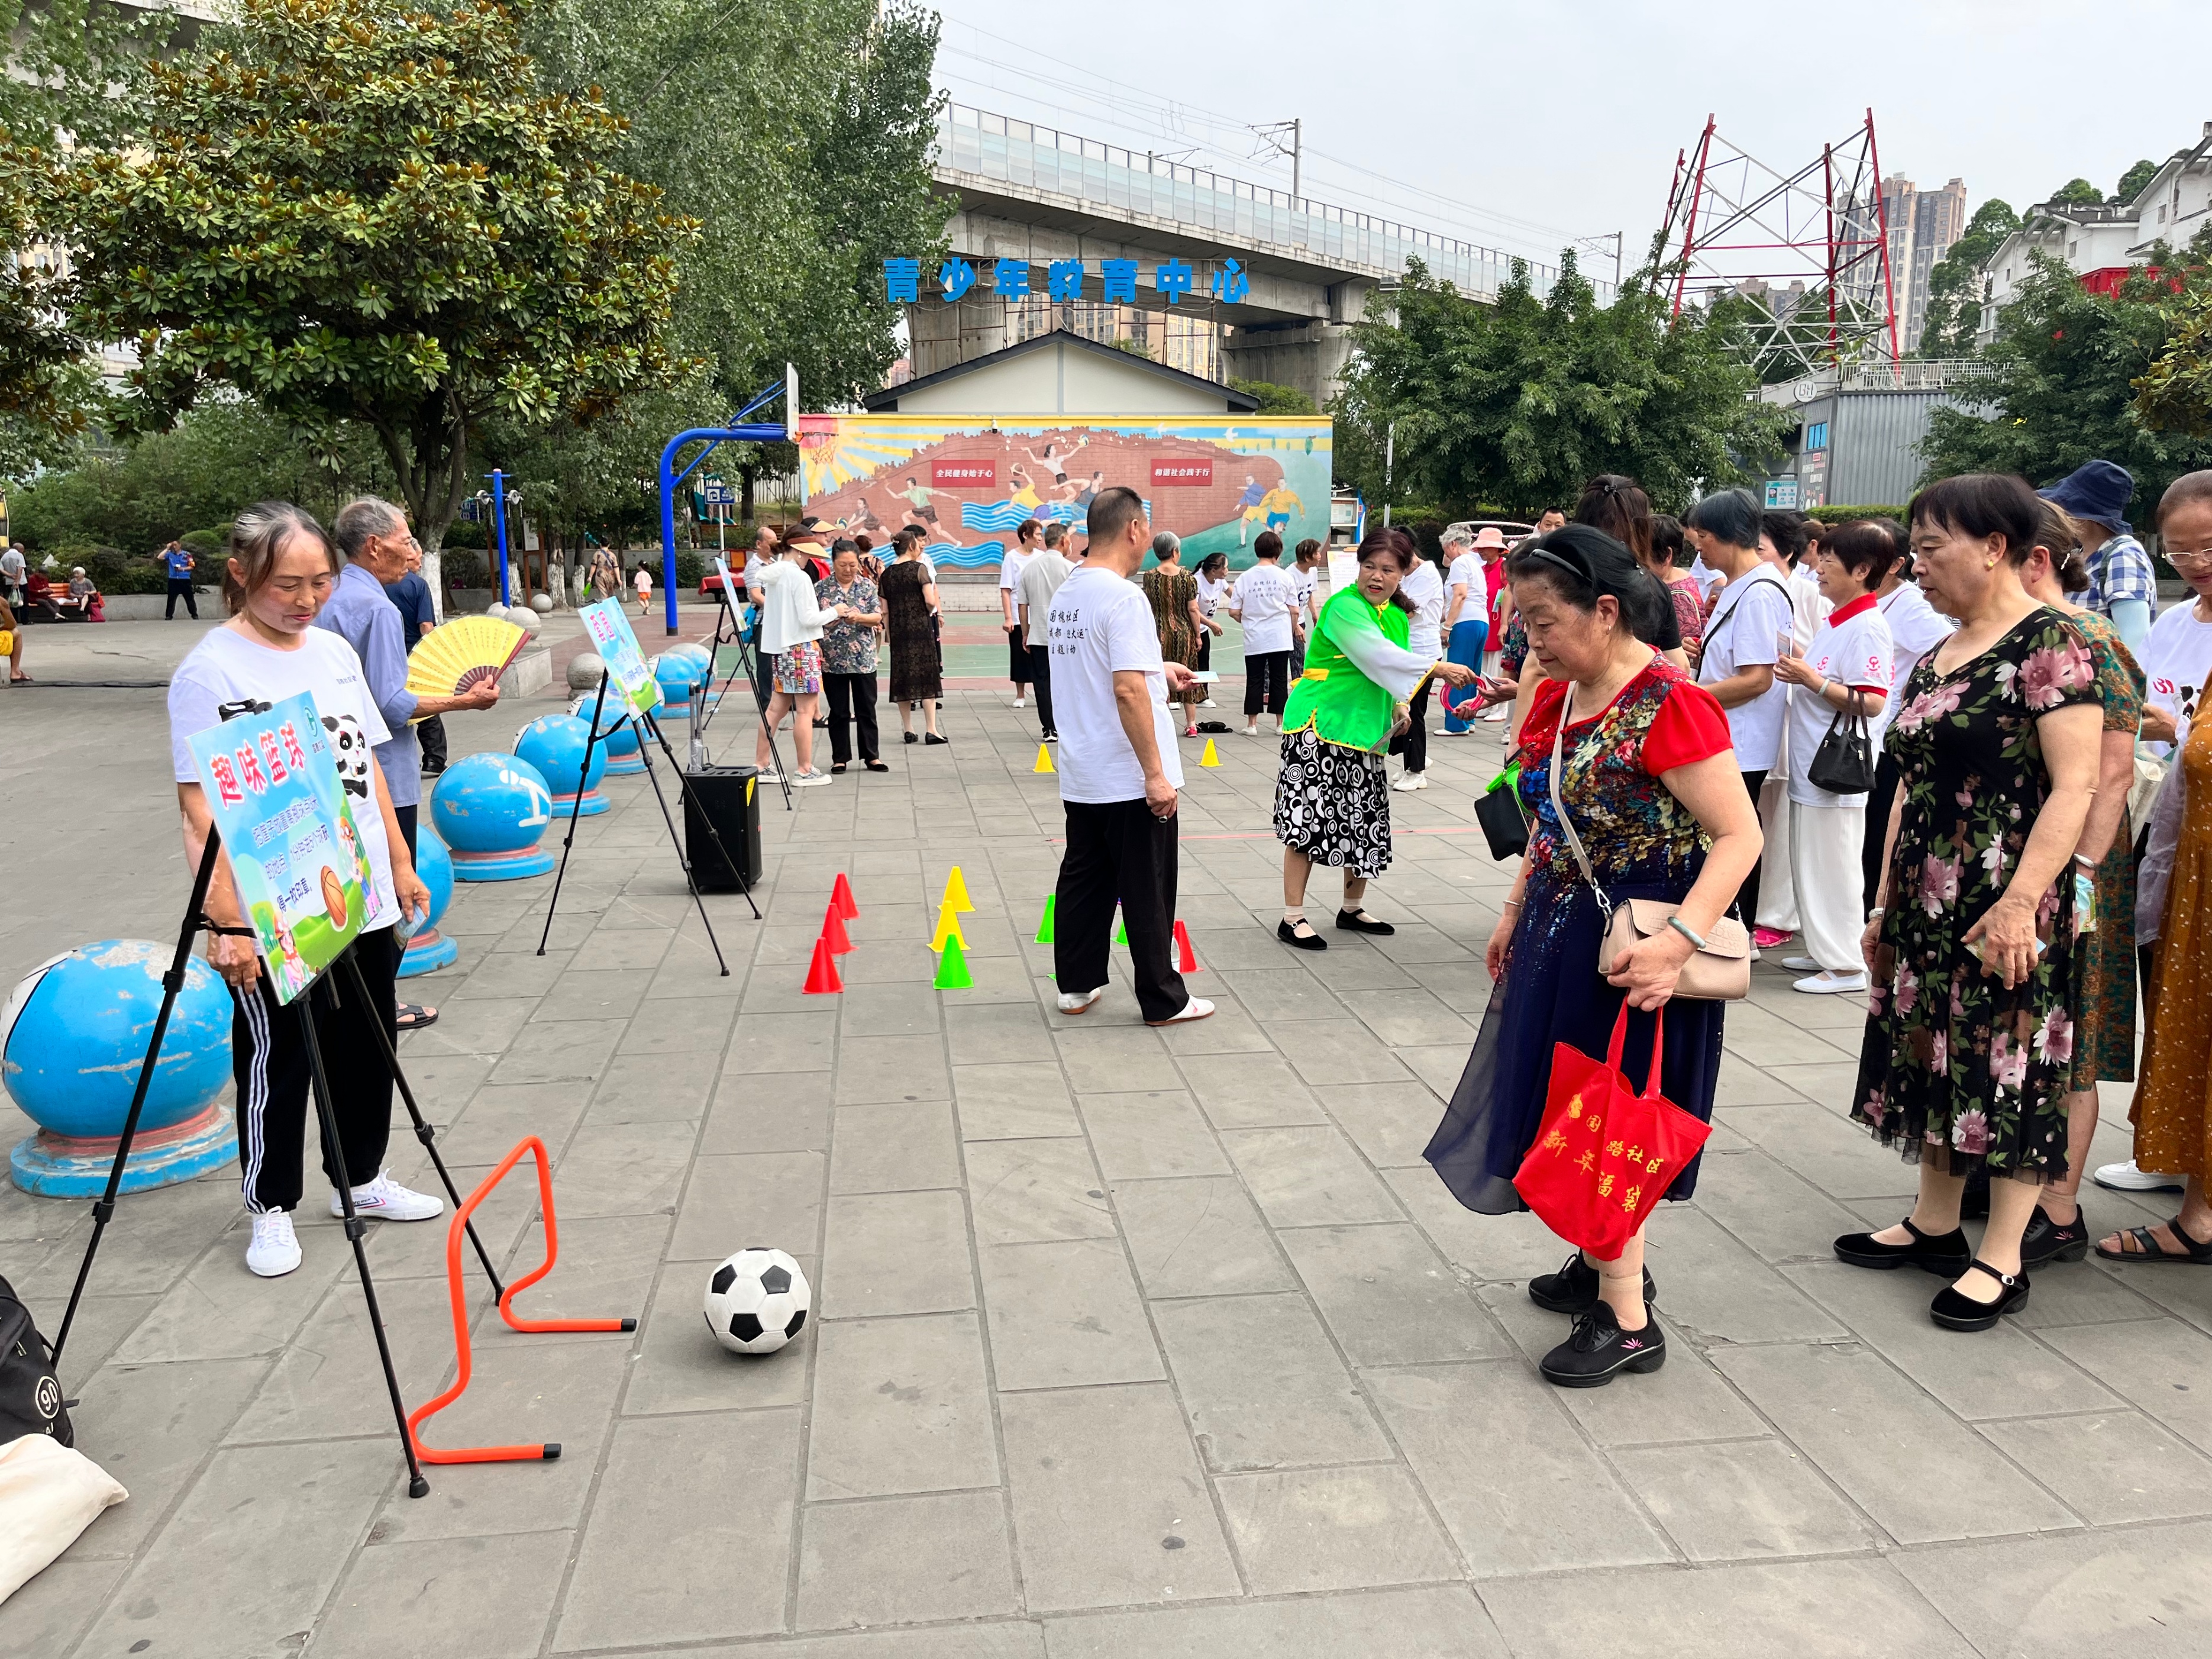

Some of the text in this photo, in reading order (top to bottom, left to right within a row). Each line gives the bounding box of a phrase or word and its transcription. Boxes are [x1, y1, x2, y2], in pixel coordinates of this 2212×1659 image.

[884, 256, 1250, 304] 青少年教育中心
[936, 469, 993, 478] 全民健身始于心
[1155, 468, 1210, 477] 和谐社会践于行
[210, 720, 306, 809] 趣味篮球
